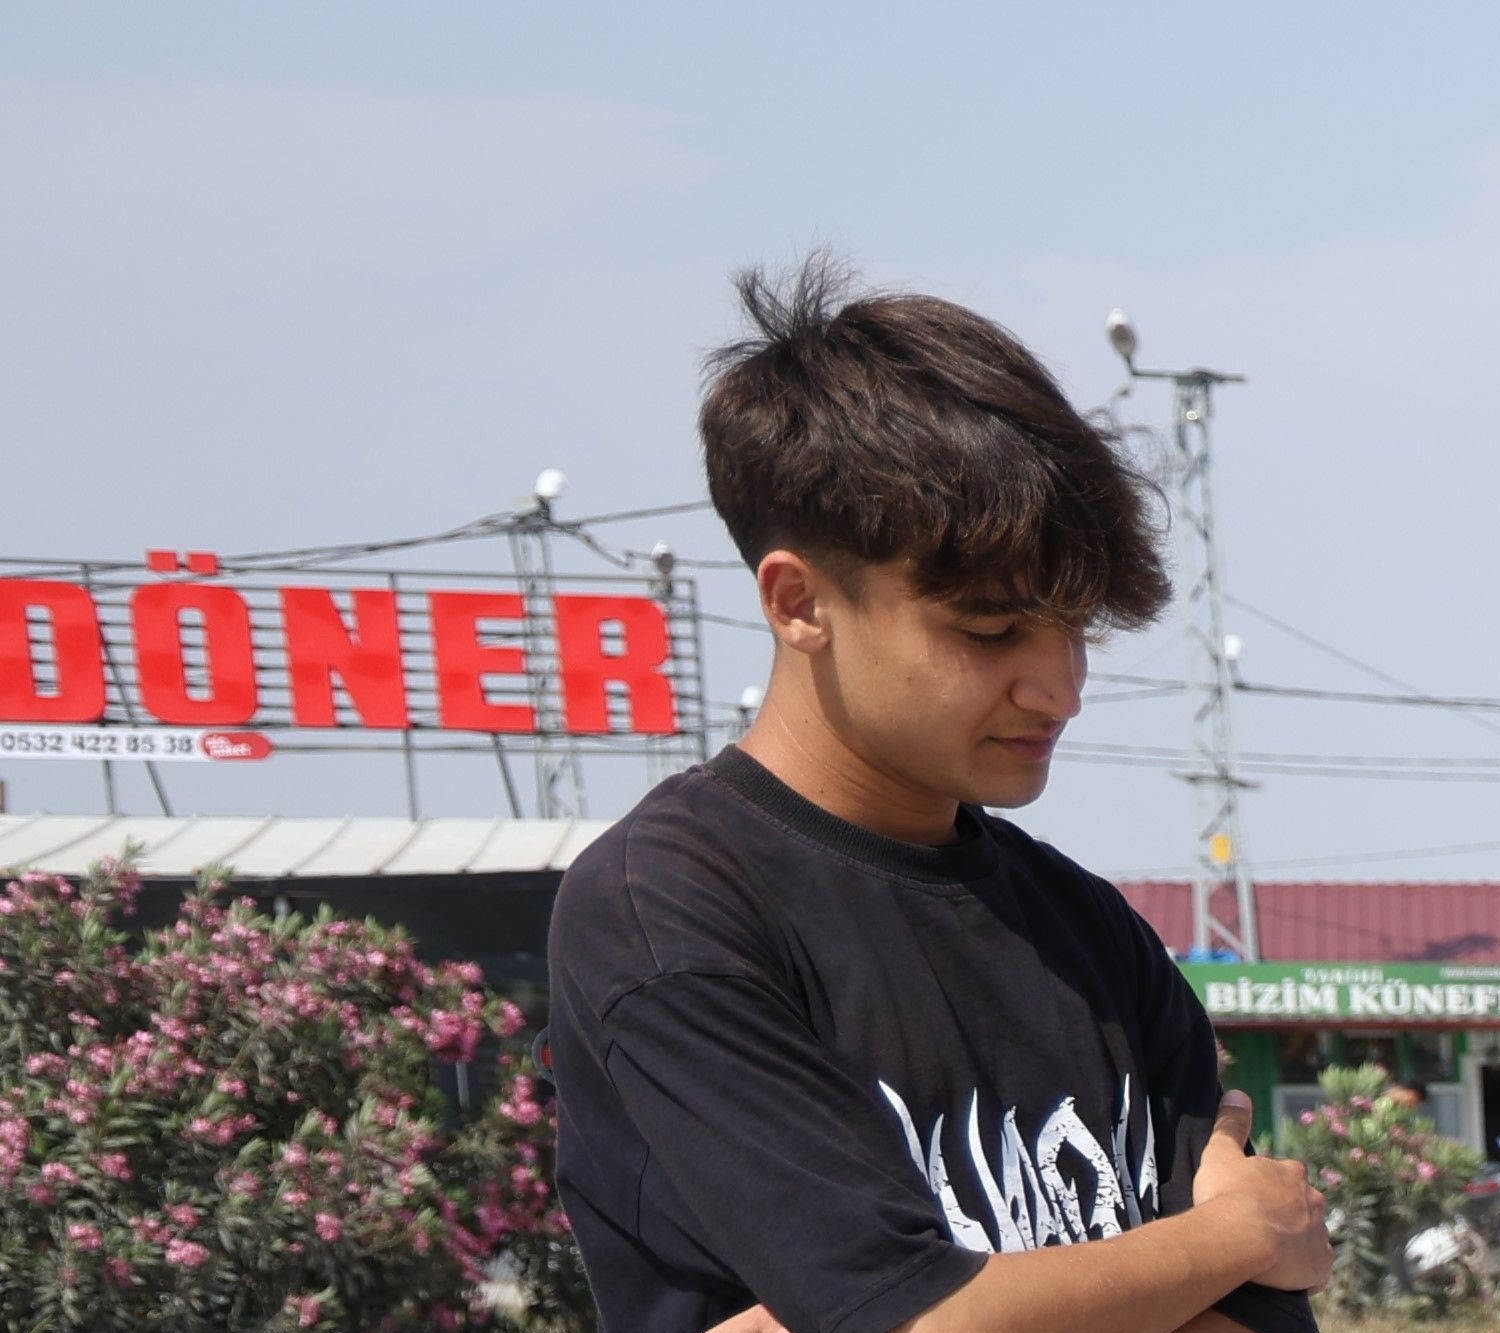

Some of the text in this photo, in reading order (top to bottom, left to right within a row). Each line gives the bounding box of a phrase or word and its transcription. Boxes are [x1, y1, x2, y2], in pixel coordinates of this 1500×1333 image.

[0, 550, 679, 735] DÖNER
[1, 732, 64, 753] 0532
[71, 733, 117, 753] 422
[1204, 976, 1337, 1015] BİZİM
